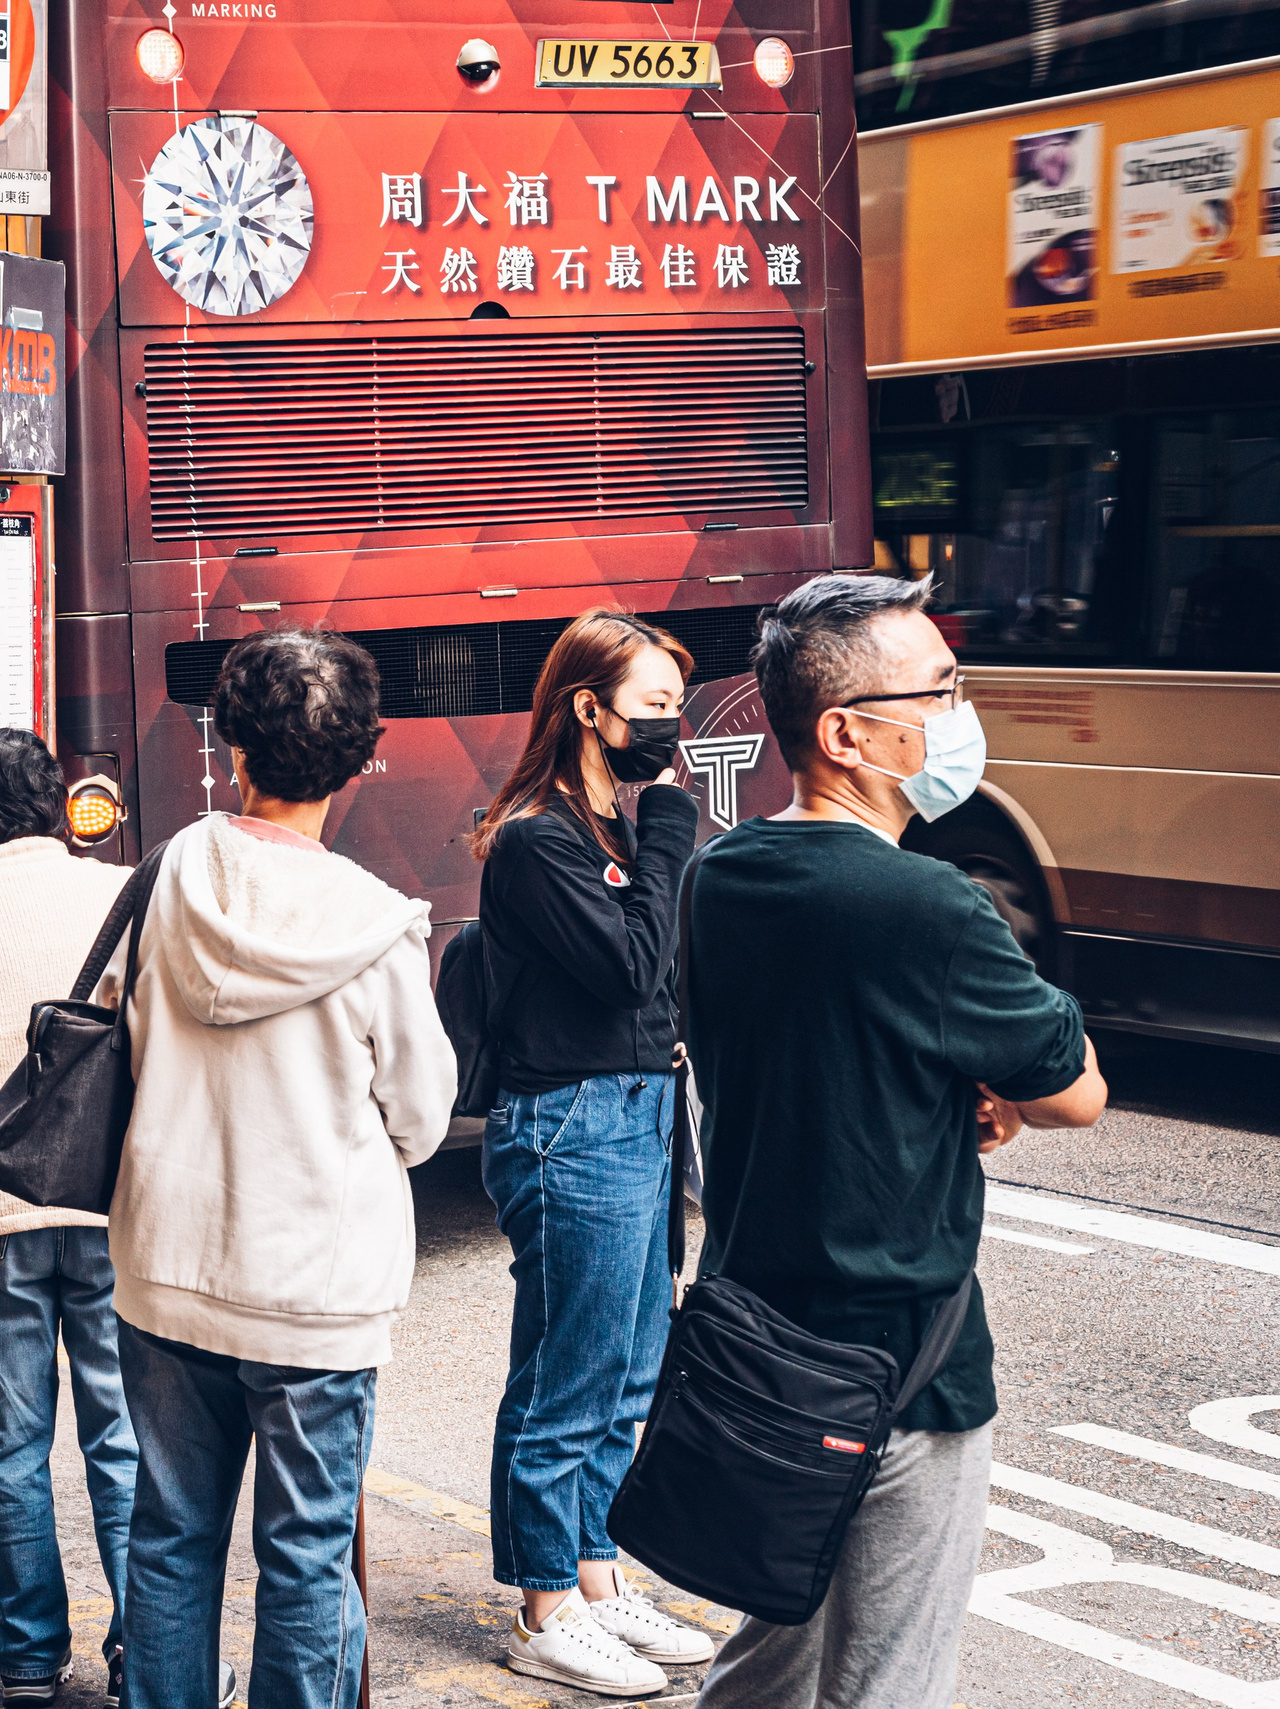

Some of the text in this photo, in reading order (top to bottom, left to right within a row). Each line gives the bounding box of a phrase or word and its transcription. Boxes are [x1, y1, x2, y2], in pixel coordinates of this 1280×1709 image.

[192, 4, 277, 18] MARKING
[553, 45, 700, 79] UV 5663
[379, 170, 801, 228] 周大福 T MARK
[381, 243, 802, 294] 天然鑽石最佳保證
